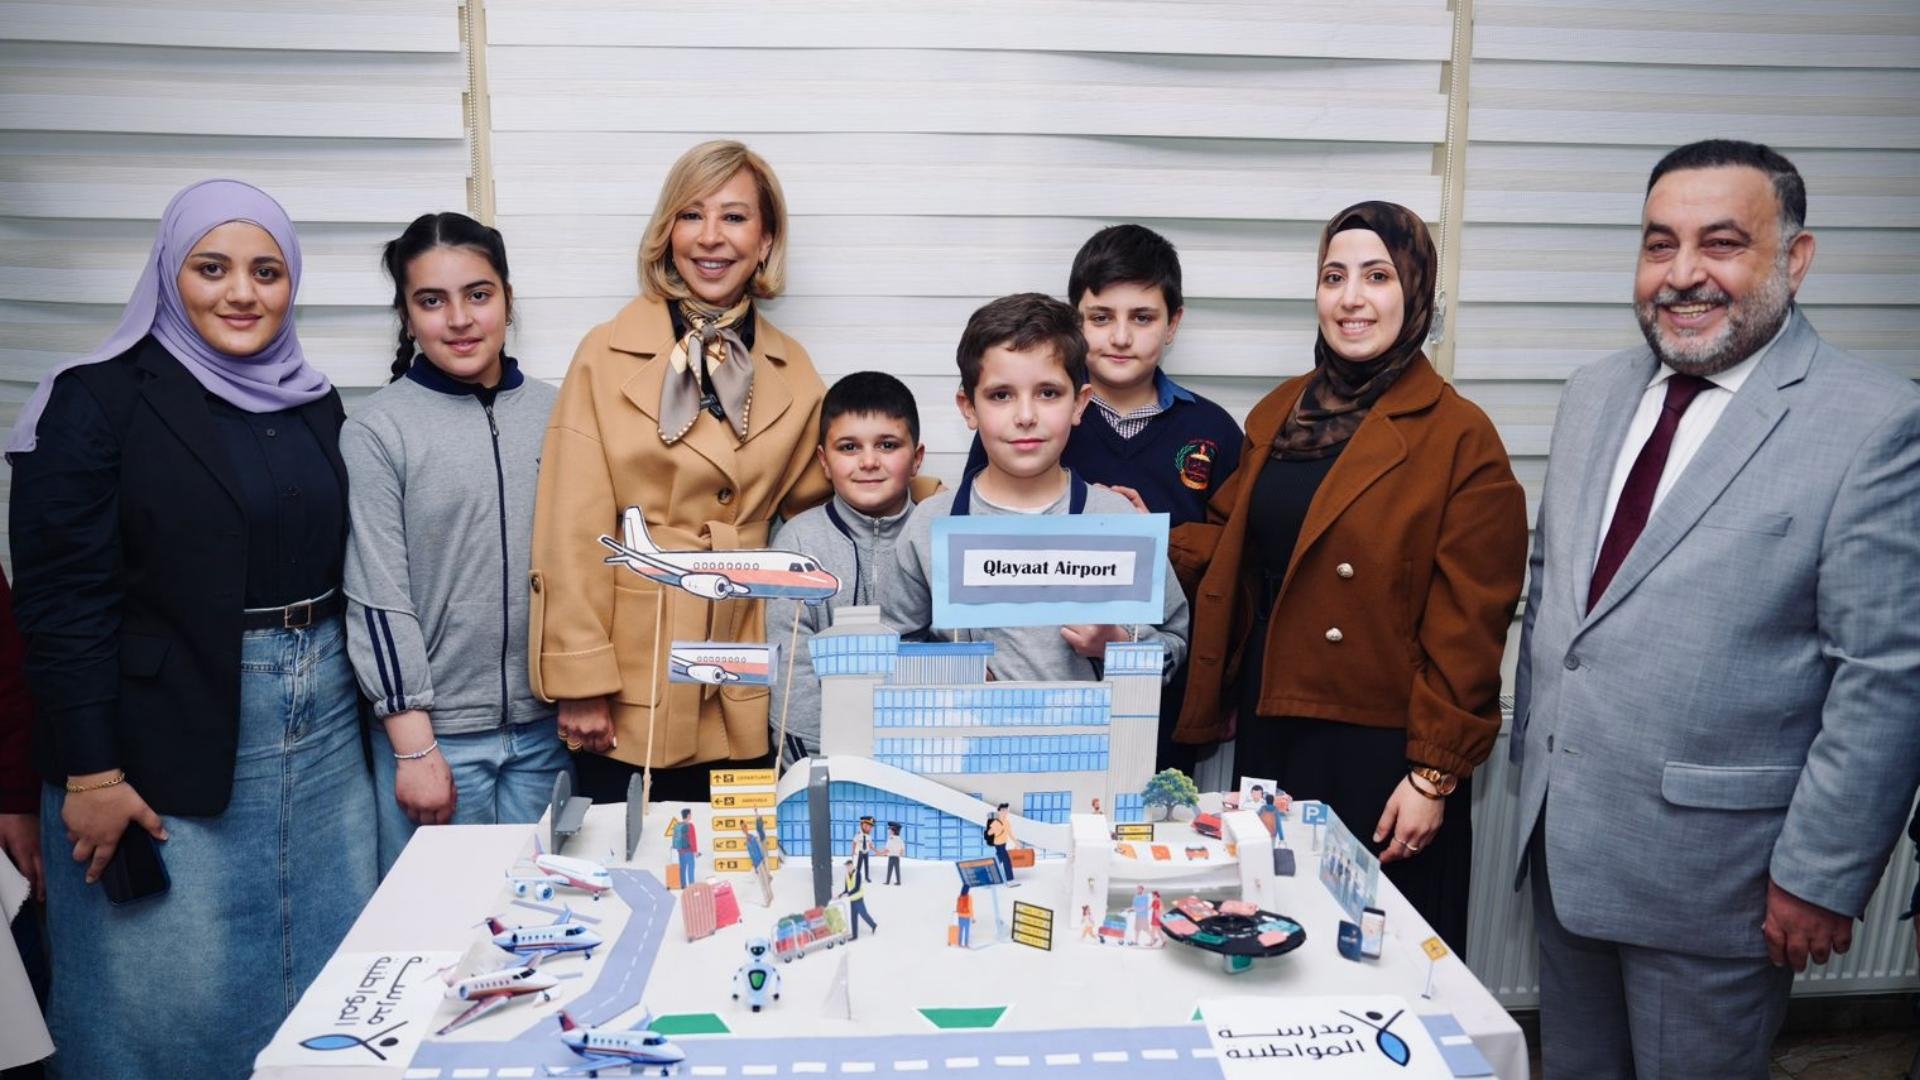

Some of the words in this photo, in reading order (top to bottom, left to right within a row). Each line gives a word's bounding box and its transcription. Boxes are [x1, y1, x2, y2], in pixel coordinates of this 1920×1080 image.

[983, 559, 1049, 577] Qlayaat
[1054, 560, 1117, 578] Airport
[1305, 806, 1320, 821] P
[367, 956, 430, 1025] مدرسة
[1218, 1023, 1354, 1039] مدرسة
